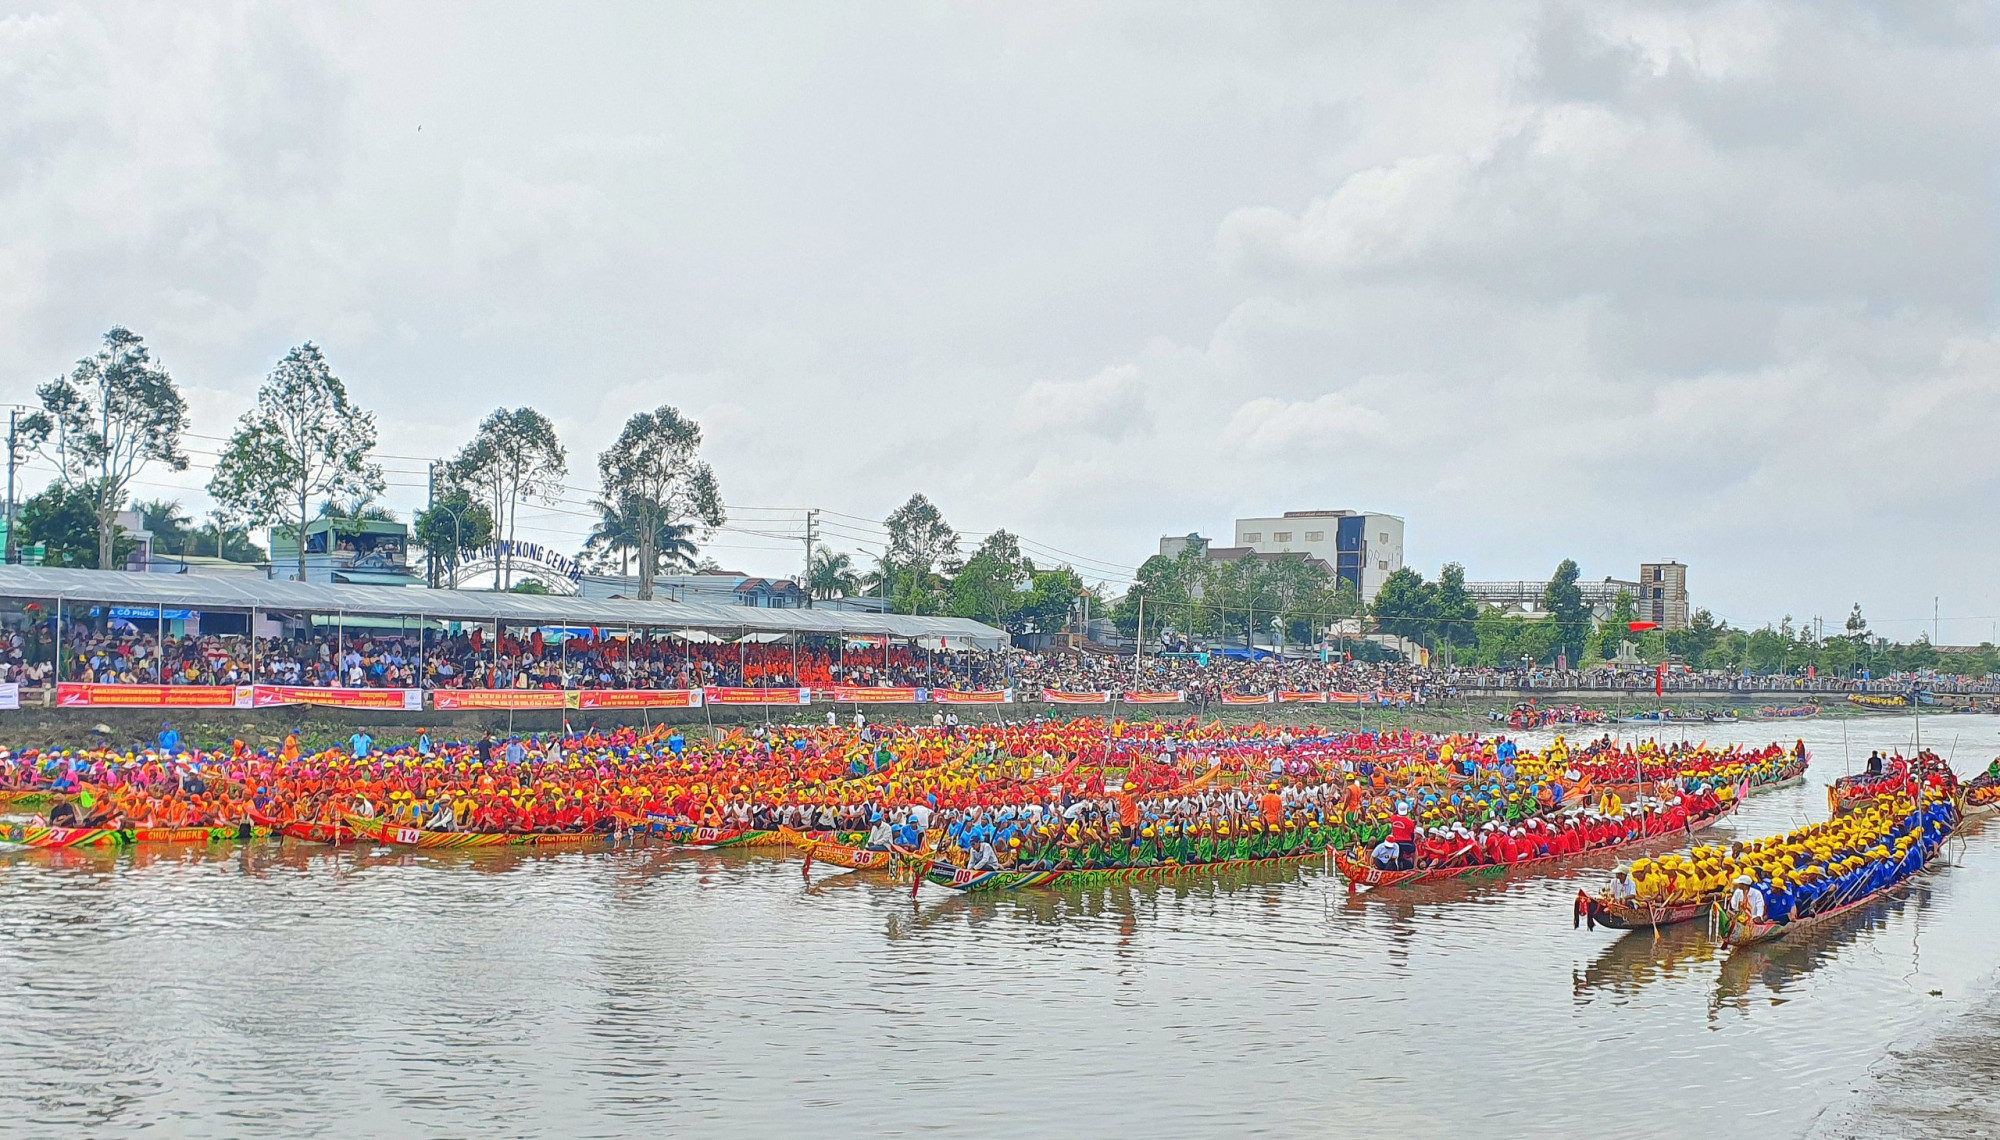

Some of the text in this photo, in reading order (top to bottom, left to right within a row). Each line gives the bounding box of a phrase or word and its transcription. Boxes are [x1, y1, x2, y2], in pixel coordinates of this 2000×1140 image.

[500, 539, 544, 562] MEKONG
[545, 550, 584, 585] CENTRE
[50, 829, 69, 841] 27
[170, 830, 203, 840] ANGKE
[400, 830, 416, 842] 14
[699, 828, 716, 839] 04
[854, 851, 871, 863] 36
[956, 870, 971, 883] 08
[1369, 870, 1380, 882] 15
